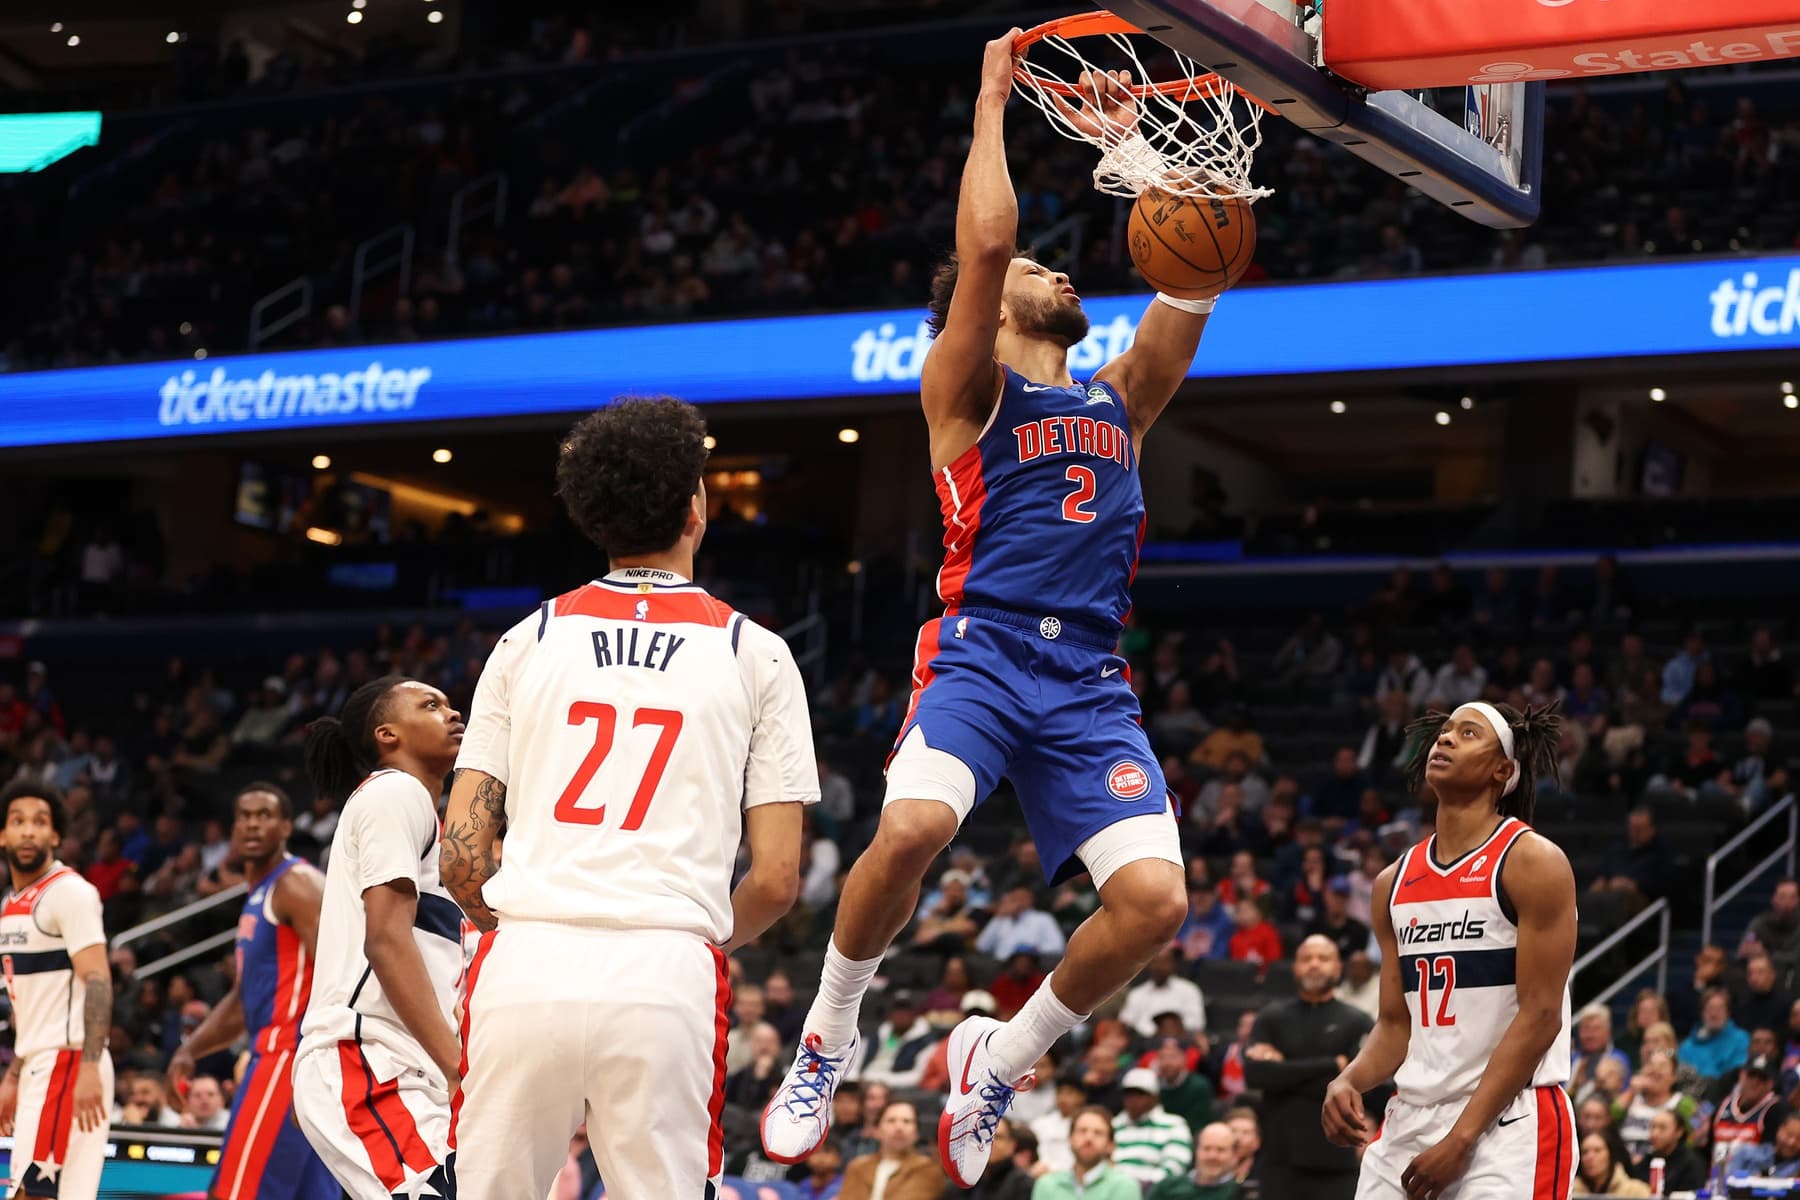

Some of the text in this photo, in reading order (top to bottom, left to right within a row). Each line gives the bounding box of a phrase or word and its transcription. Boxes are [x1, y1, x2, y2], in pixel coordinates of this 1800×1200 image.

[159, 361, 432, 426] ticketmaster
[1012, 416, 1129, 471] DETROIT
[1061, 464, 1097, 523] 2
[625, 568, 674, 581] NIKE PRO
[591, 627, 686, 672] RILEY
[553, 700, 684, 831] 27
[1415, 955, 1457, 1028] 12
